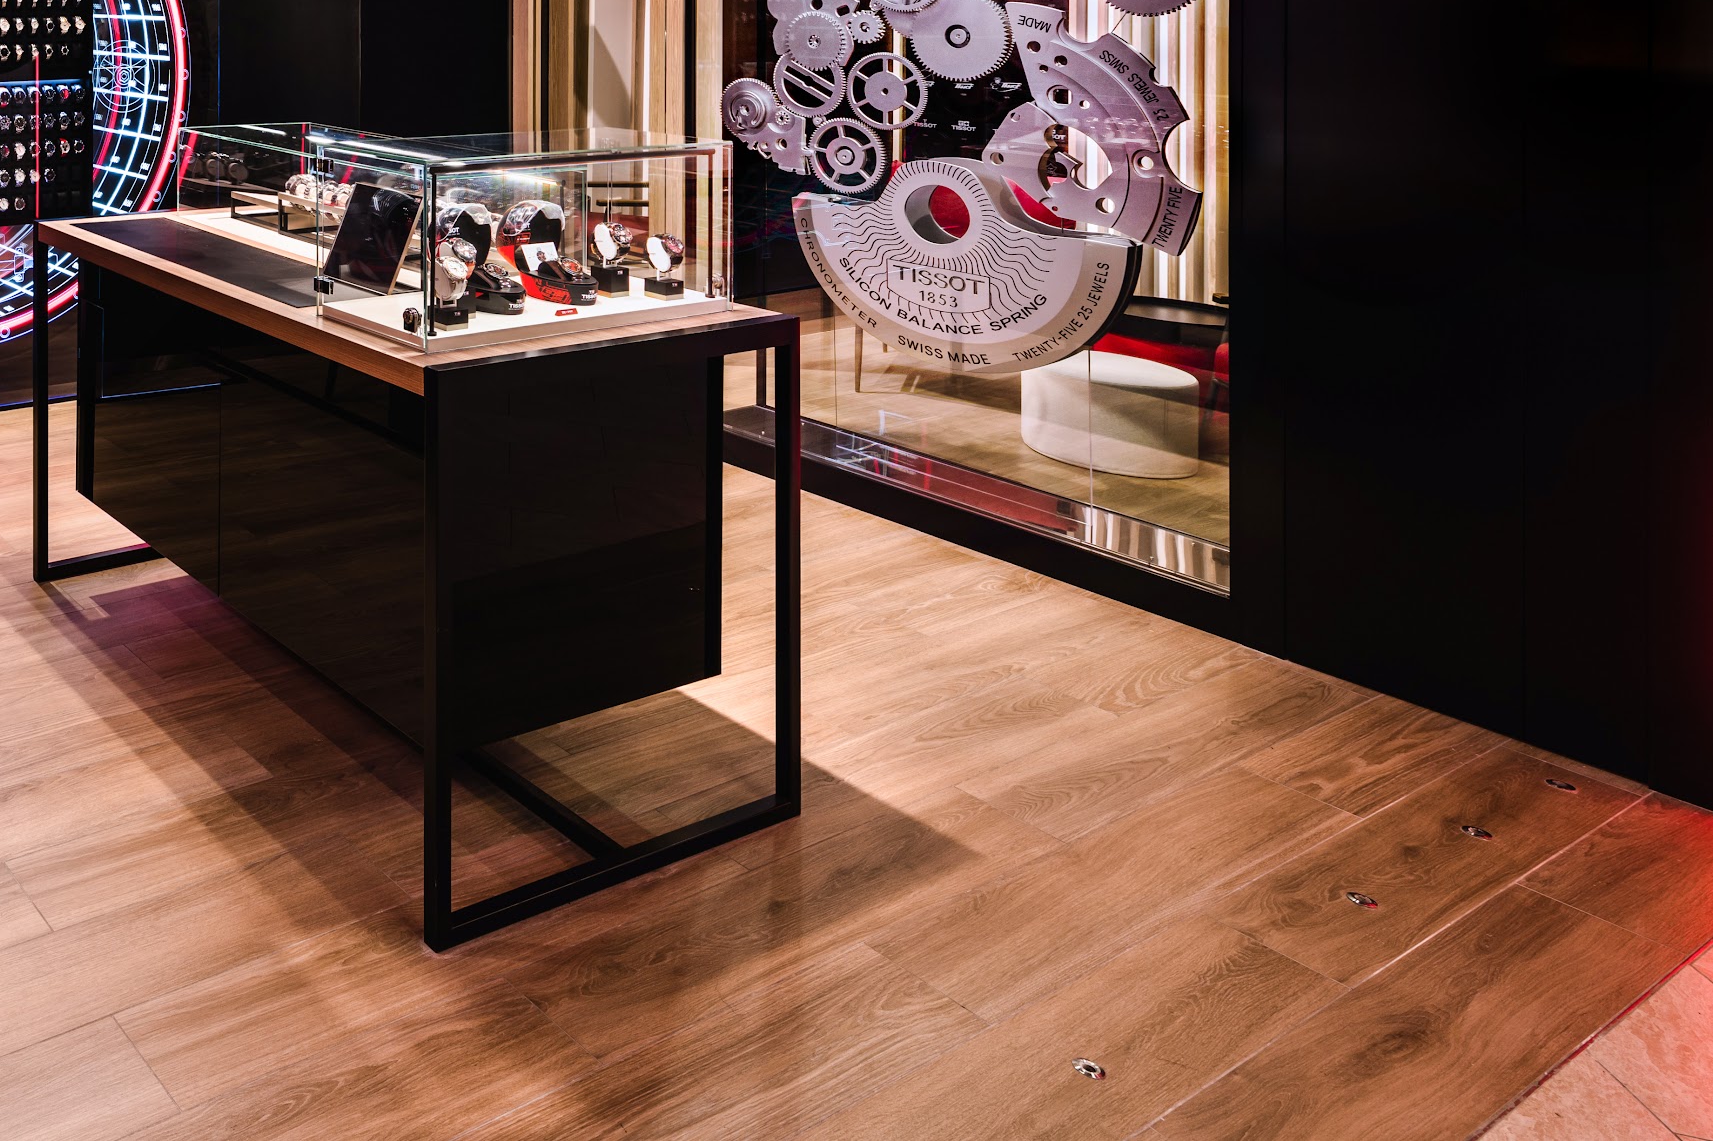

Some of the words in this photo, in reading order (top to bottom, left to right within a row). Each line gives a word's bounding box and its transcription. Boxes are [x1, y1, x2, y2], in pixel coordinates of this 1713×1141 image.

[1018, 14, 1052, 34] MADE
[1099, 49, 1130, 75] SWISS
[1129, 73, 1160, 105] JEWELS
[1168, 186, 1182, 209] FIVE
[1152, 209, 1178, 248] TWENTY
[800, 217, 877, 329] CHRONOMETER
[893, 265, 986, 296] TISSOT
[839, 256, 891, 311] SILICON
[897, 308, 984, 335] BALANCE
[989, 294, 1047, 331] SPRING
[918, 289, 958, 309] 1853
[1012, 319, 1083, 361] TWENTY-FIVE
[1077, 306, 1093, 320] 25
[1087, 262, 1110, 307] JEWELS
[898, 335, 944, 360] SWISS
[948, 351, 991, 365] MADE
